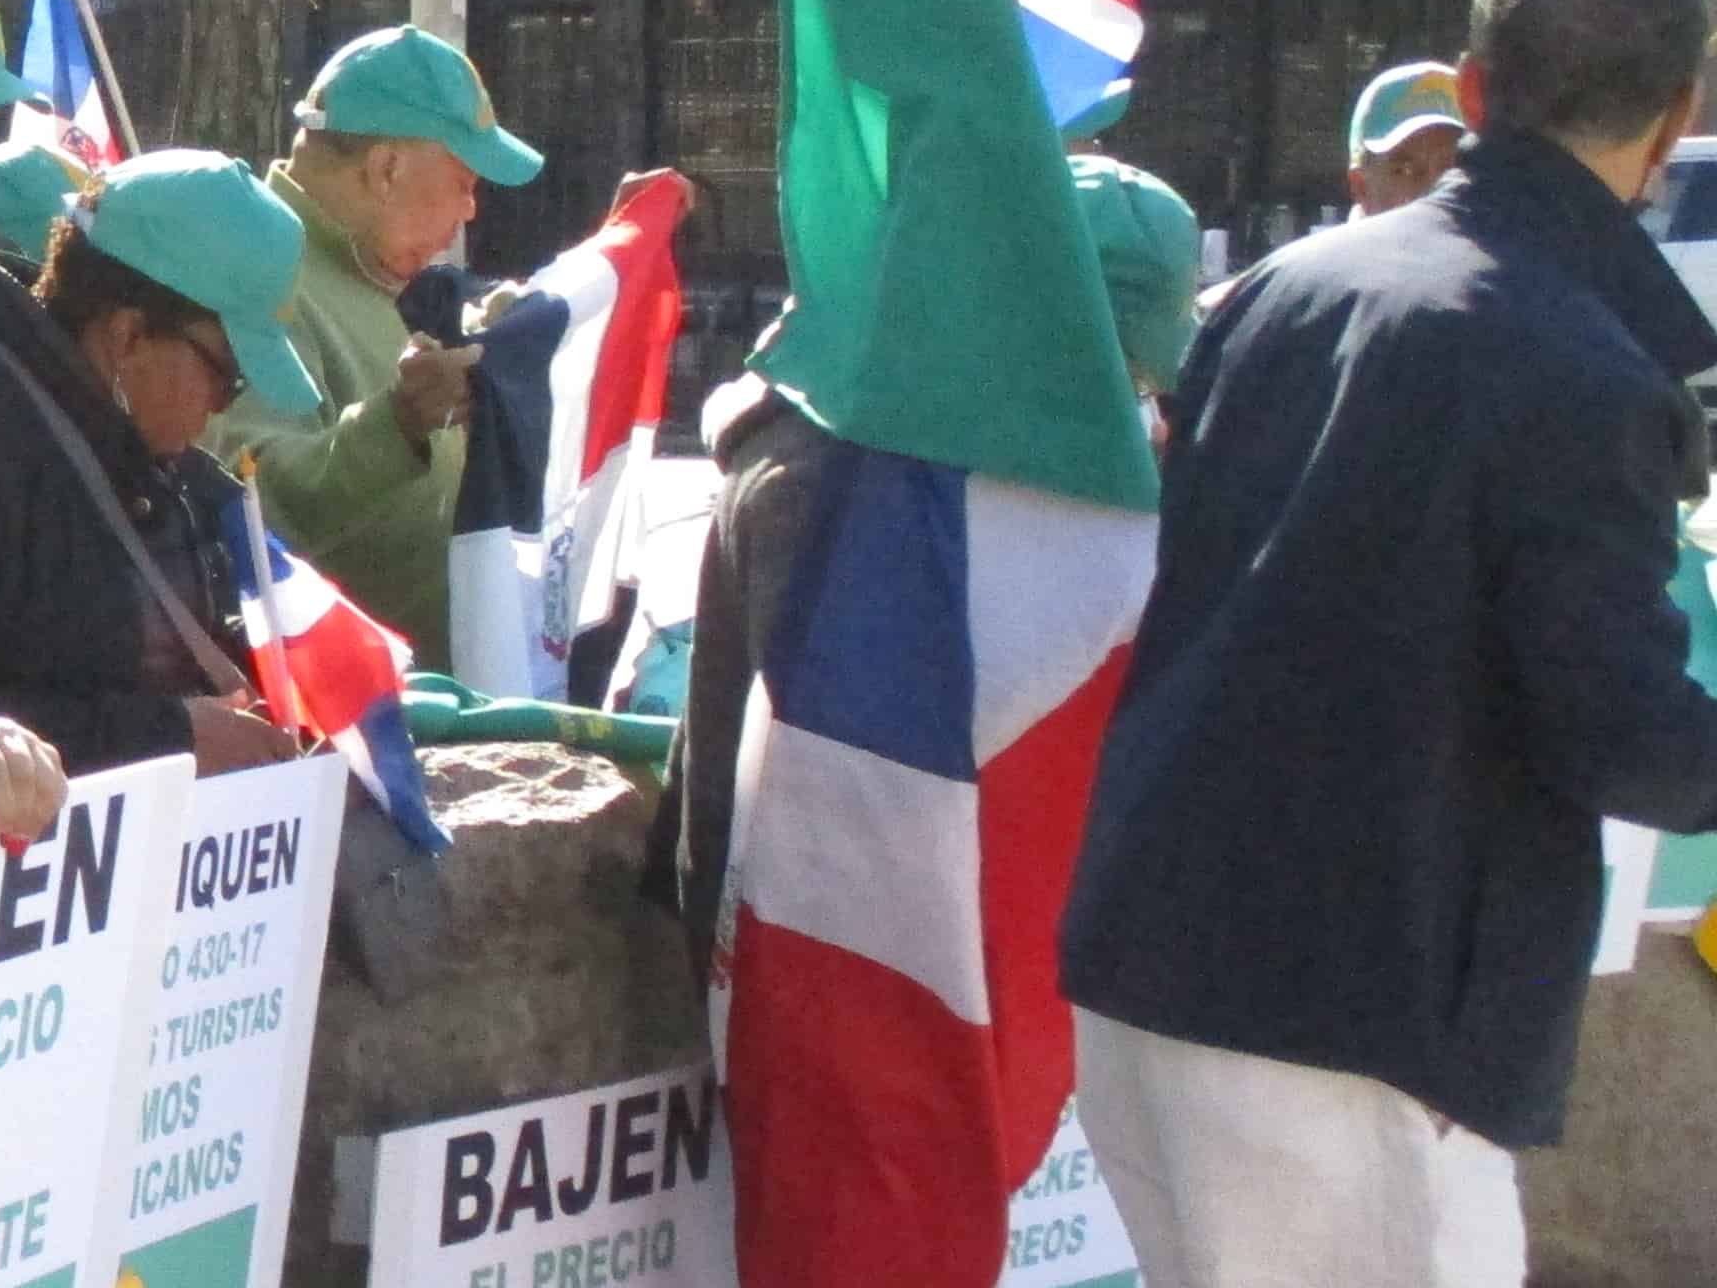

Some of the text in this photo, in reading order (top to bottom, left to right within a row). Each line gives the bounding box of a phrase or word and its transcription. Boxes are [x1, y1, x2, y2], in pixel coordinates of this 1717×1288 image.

[176, 817, 302, 913] IQUEN
[186, 922, 267, 983] 430-17
[166, 987, 283, 1065] TURISTAS
[130, 1130, 244, 1220] ICANOS
[438, 1080, 715, 1249] BAJEN
